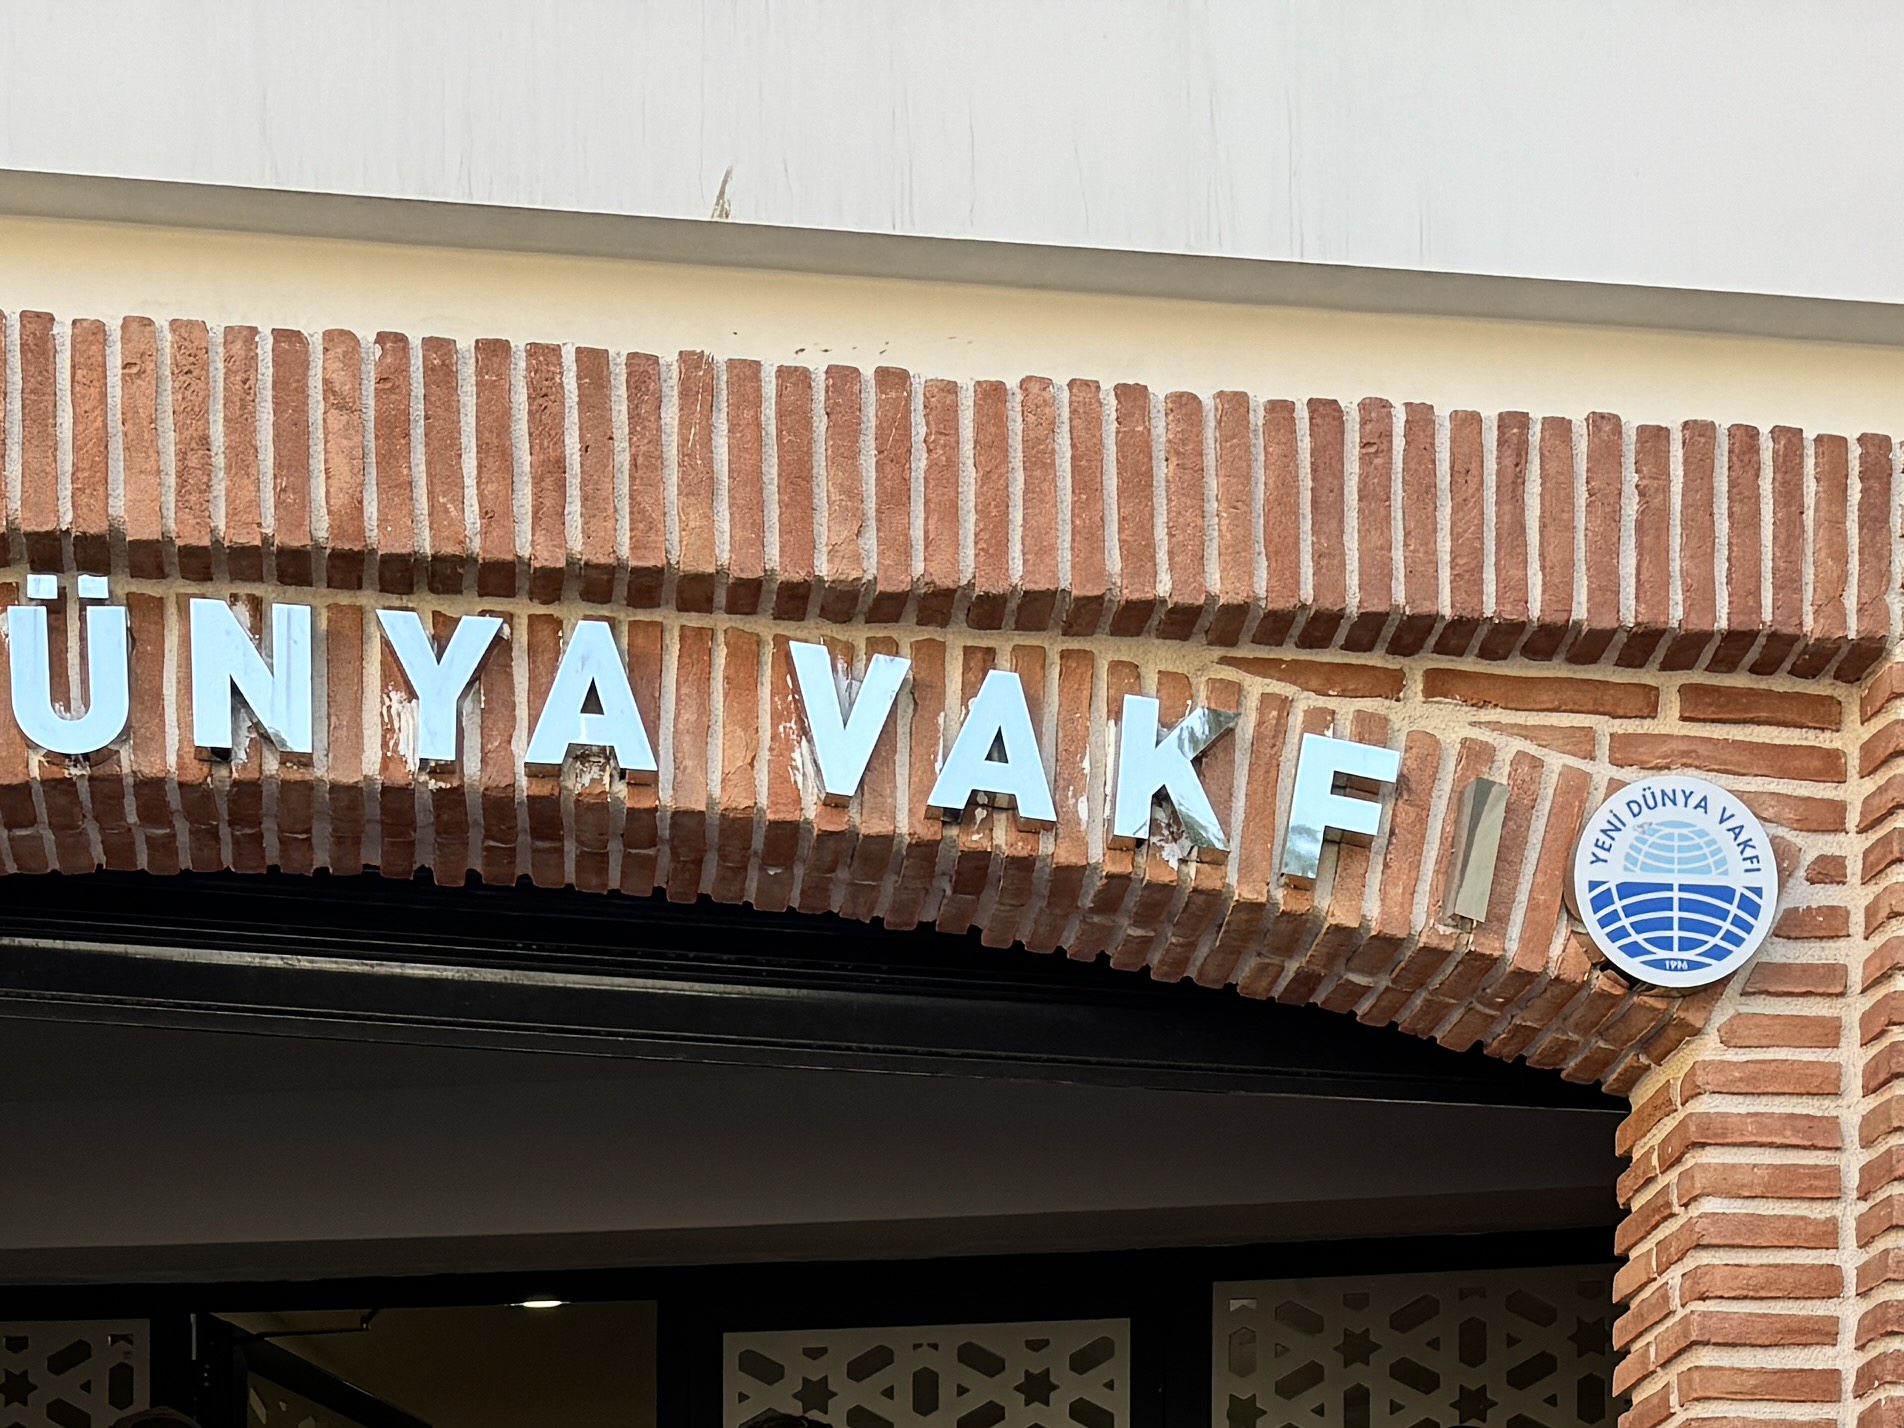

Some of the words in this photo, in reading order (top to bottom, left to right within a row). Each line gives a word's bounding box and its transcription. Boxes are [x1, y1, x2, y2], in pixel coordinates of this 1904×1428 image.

[1589, 808, 1627, 866] YENİ
[1626, 786, 1709, 819] DÜNYA
[1719, 806, 1762, 874] VAKFI
